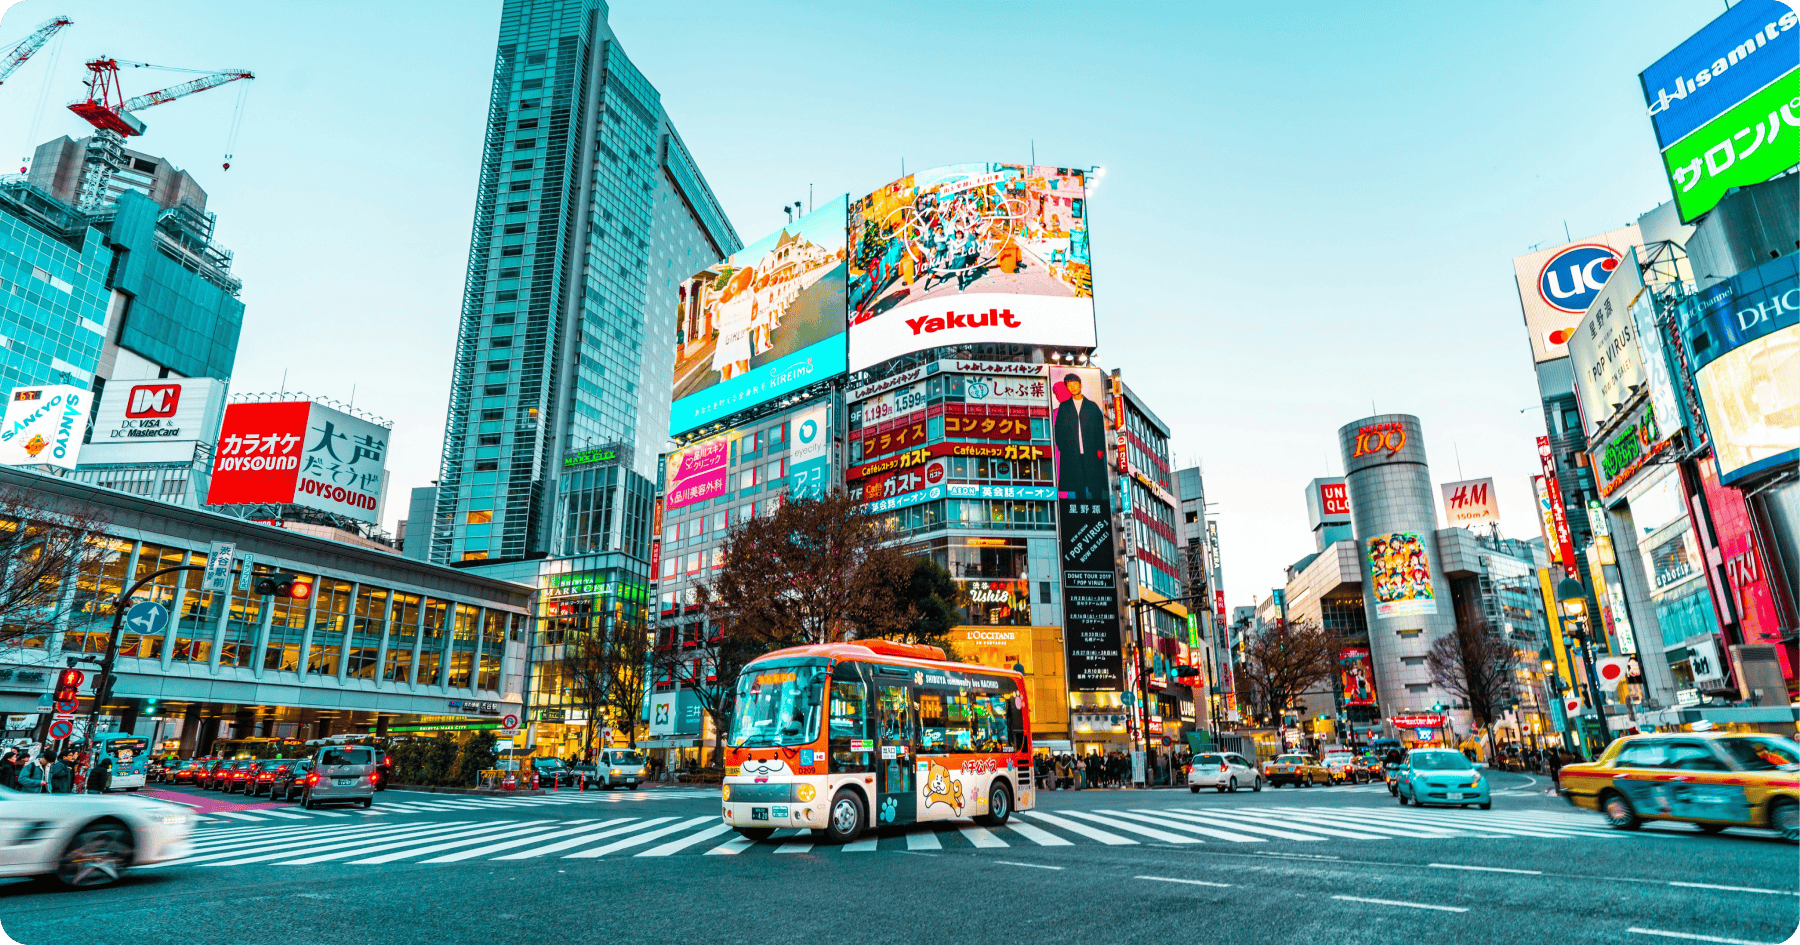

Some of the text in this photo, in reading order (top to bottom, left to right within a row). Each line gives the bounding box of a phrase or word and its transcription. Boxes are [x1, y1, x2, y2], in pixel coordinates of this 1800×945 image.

[1697, 286, 1733, 312] Channel
[1736, 287, 1800, 331] DHC
[904, 308, 1022, 335] Yakult
[769, 363, 814, 389] KIREIMO
[956, 361, 1044, 375] しゃぶしゃぶバイキング
[854, 368, 921, 399] しゃぶしゃぶバイキング
[993, 381, 1045, 397] しゃぶ葉
[129, 388, 176, 415] DC
[1, 395, 62, 442] SANKYO
[121, 418, 174, 429] DC VISA &
[850, 410, 862, 423] 9F
[945, 417, 1028, 435] コンタクト
[53, 393, 80, 460] SANKYO
[110, 427, 180, 438] DC MasterCard
[1359, 422, 1403, 435] SHIBUYA
[222, 432, 301, 456] カラオケ
[307, 420, 386, 464] 大声
[864, 424, 925, 455] プライス
[1352, 428, 1407, 459] 109
[693, 443, 725, 463] 品川スキン
[794, 442, 822, 458] eyecity
[1004, 444, 1044, 460] ガスト
[217, 455, 298, 473] JOYSOUND
[693, 454, 721, 472] クリニック
[304, 456, 380, 496] だそうぜ。
[883, 472, 922, 498] ガスト
[298, 477, 377, 512] JOYSOUND
[674, 479, 723, 504] 品川美容外科
[850, 487, 863, 501] 7F
[950, 486, 976, 497] AEON
[982, 487, 1056, 499] 英会話イーオン
[1450, 482, 1489, 510] H&M
[1457, 511, 1481, 521] 150m
[1080, 550, 1092, 563] NOW
[1090, 544, 1098, 552] ON
[213, 546, 232, 588] 渋谷駅前
[544, 586, 578, 597] MARK
[561, 579, 594, 587] SHIBUYA
[970, 589, 1009, 603] Ushi8
[967, 631, 1015, 640] L'OCCITANE
[798, 767, 816, 775] D209
[960, 757, 999, 776] ハチ公バス
